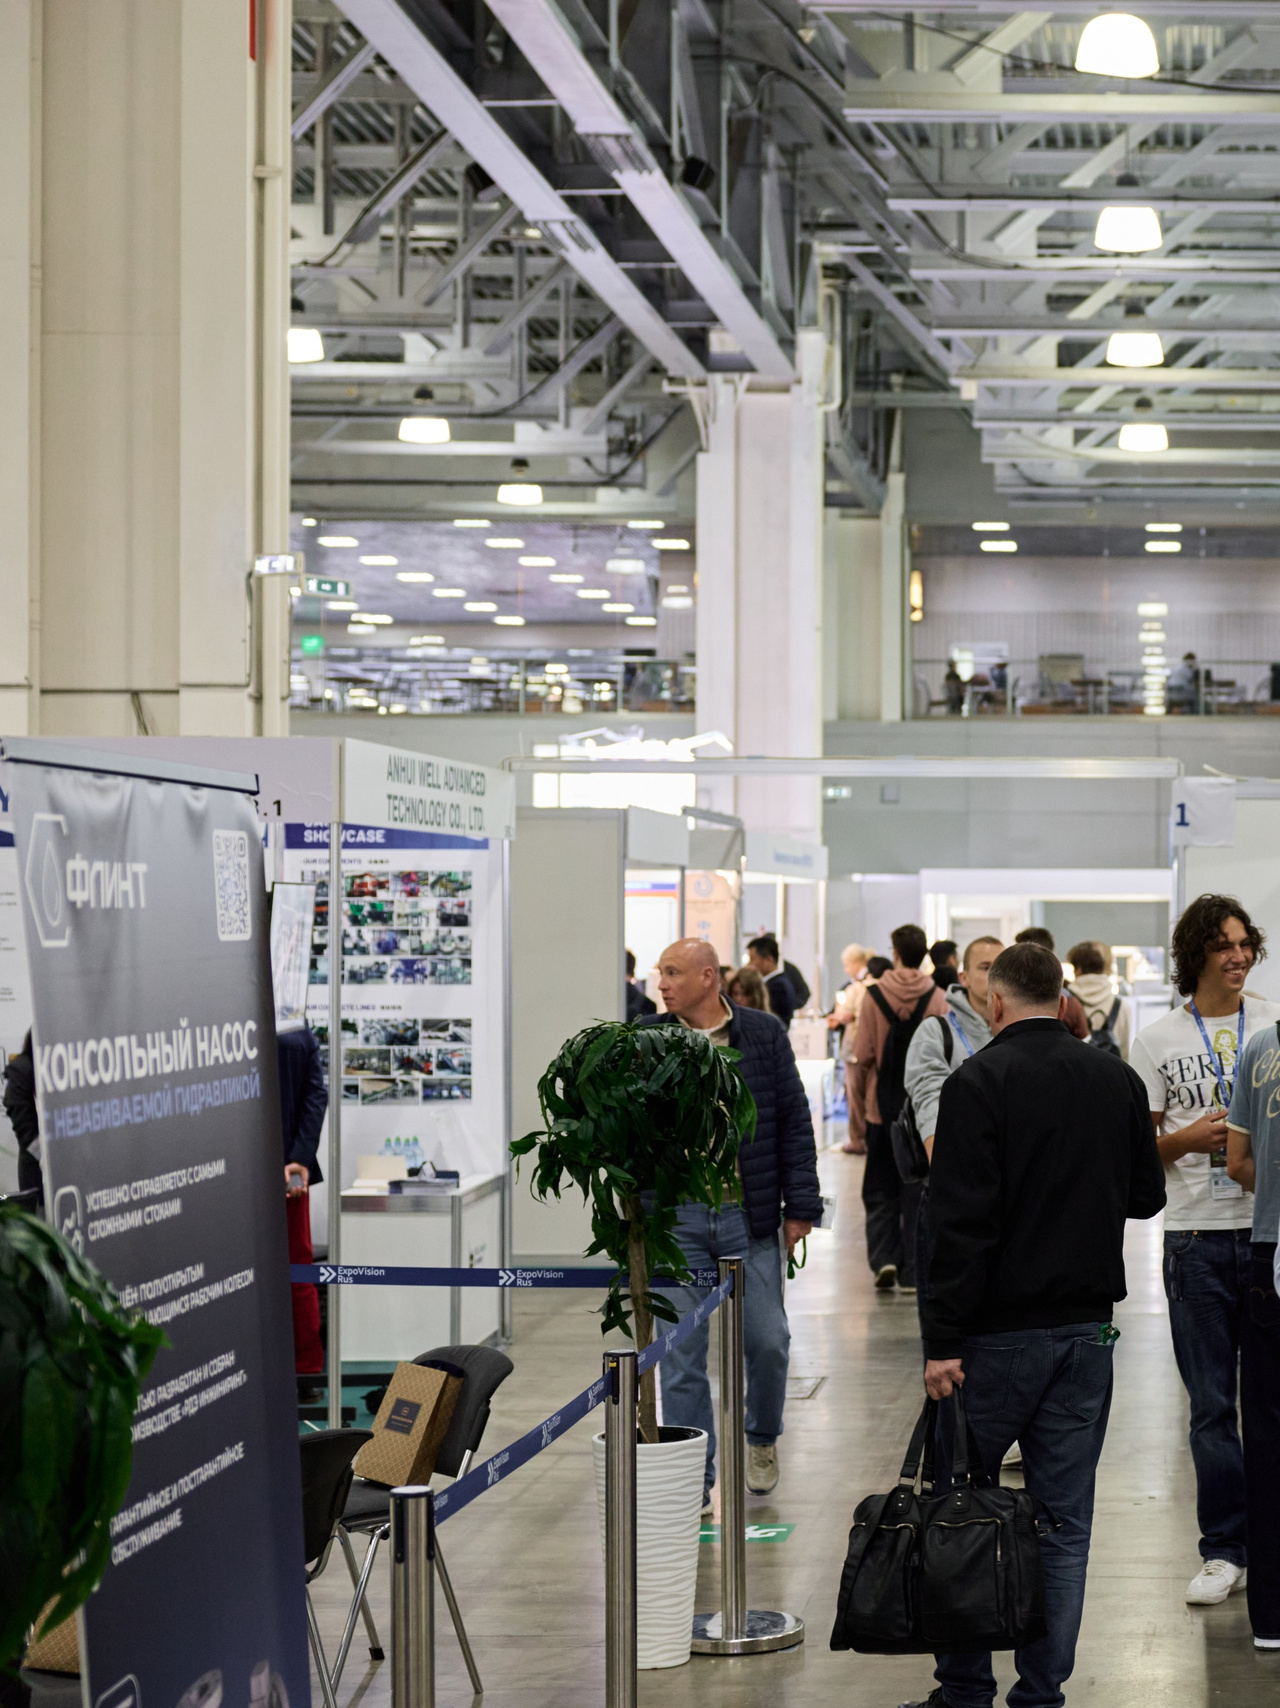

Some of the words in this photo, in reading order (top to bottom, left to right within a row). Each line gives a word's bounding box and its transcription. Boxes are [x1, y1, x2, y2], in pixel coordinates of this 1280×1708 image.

[387, 754, 416, 783] ANHUI
[418, 760, 441, 789] WELL
[443, 767, 486, 797] ADVANCED
[387, 794, 447, 826] TECHNOLOGY
[468, 808, 486, 831] LTD.
[1176, 802, 1190, 826] 1
[66, 853, 147, 909] ФЛИНТ
[37, 1017, 193, 1093] КОНСОЛЬНЫЙ
[197, 1020, 258, 1069] НАСОС
[54, 1083, 172, 1140] НЕЗАБИВАЕМОЙ
[175, 1067, 261, 1118] ГИДРАВЛИКОЙ
[86, 1184, 130, 1214] УСПЕШНО
[130, 1168, 187, 1201] СПРАВЛЯЕТСЯ
[194, 1158, 226, 1184] САМЫМИ
[88, 1207, 143, 1242] СЛОЖНЫМИ
[144, 1198, 182, 1225] СТОКАМИ
[140, 1262, 204, 1302] ПОЛУОТКРЫТЫМ
[190, 1280, 223, 1309] РАБОЧИМ
[224, 1267, 254, 1295] КОЛЕСОМ
[337, 1267, 385, 1277] ExpoVision
[337, 1275, 354, 1284] Rus
[516, 1269, 564, 1280] ExpoVision
[516, 1278, 532, 1287] Rus
[157, 1367, 203, 1404] РАЗРАБОТАН
[209, 1350, 235, 1377] СОБРАН
[112, 1507, 183, 1566] ОБСЛУЖИВАНИЕ
